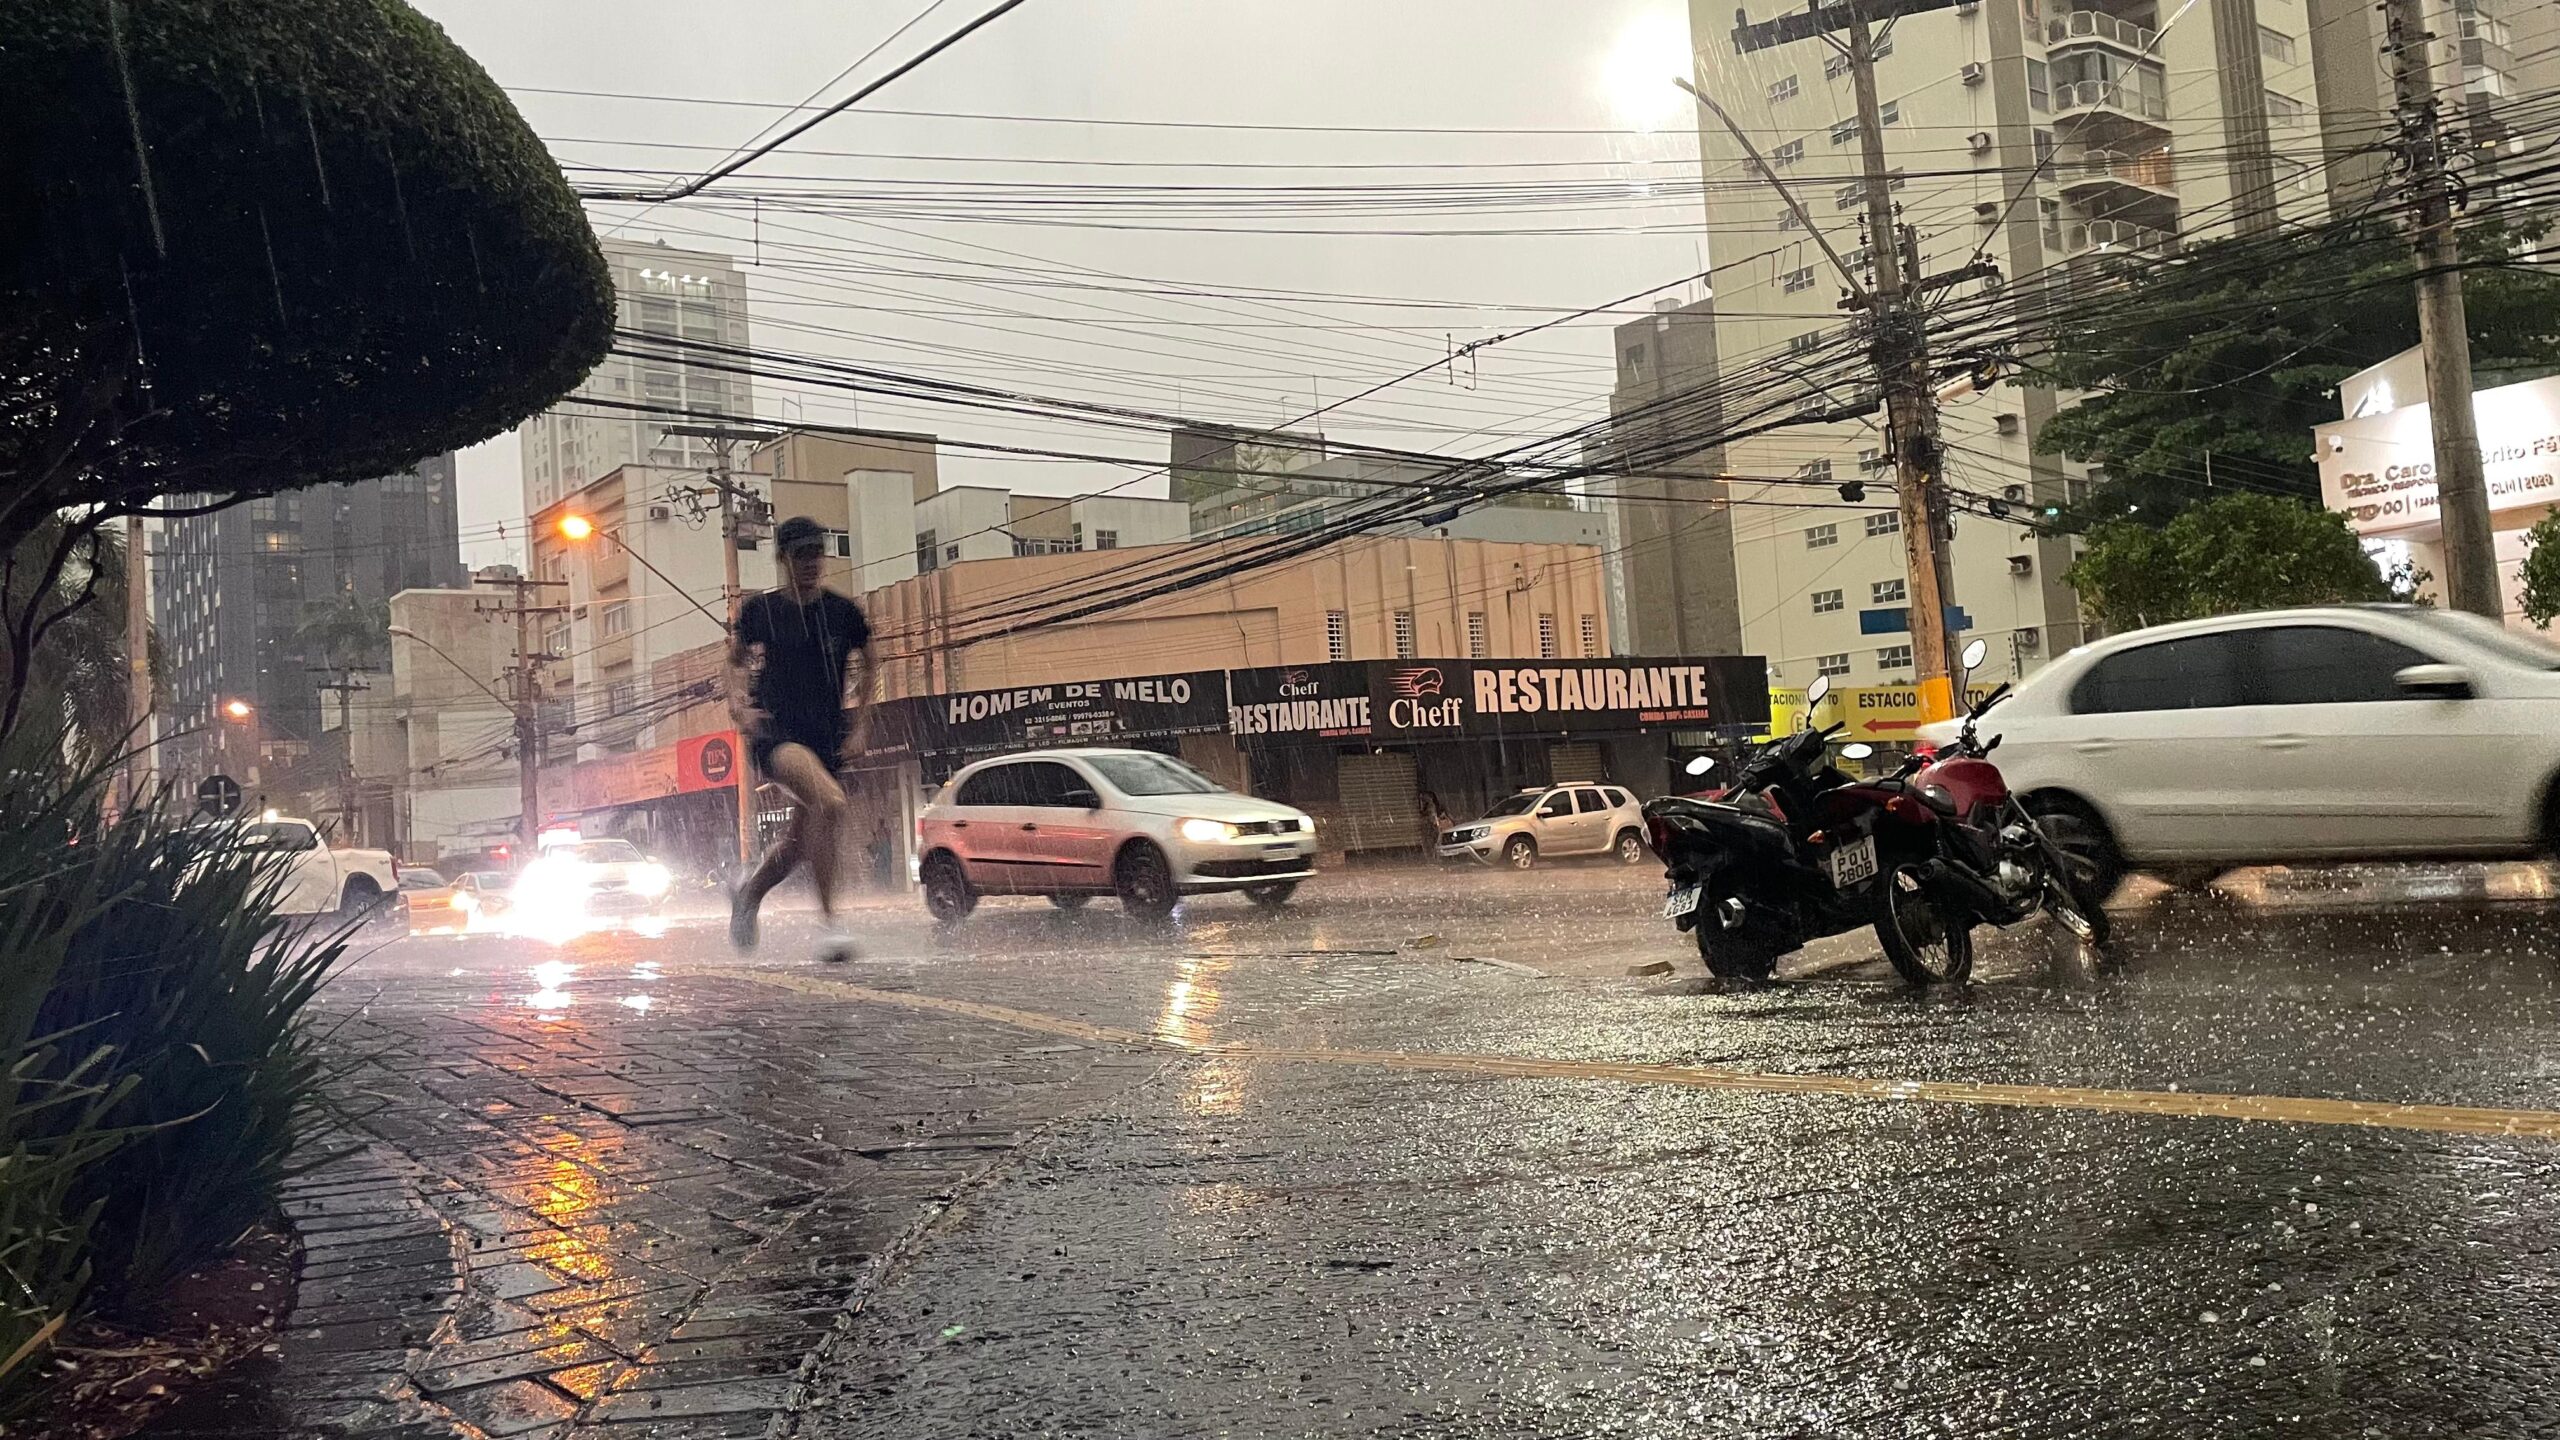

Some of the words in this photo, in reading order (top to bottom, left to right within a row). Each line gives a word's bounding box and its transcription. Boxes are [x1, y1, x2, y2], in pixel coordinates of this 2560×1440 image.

[2340, 472, 2380, 489] Dra.
[2386, 463, 2432, 481] Caro
[949, 688, 1052, 724] HOMEM
[1066, 683, 1101, 698] DE
[1115, 679, 1191, 704] MELO
[1279, 682, 1319, 697] Cheff
[1473, 666, 1708, 713] RESTAURANTE
[1048, 700, 1090, 710] EVENTOS
[1231, 696, 1372, 735] RESTAURANTE
[1389, 698, 1463, 729] Cheff
[1838, 845, 1869, 871] PQU
